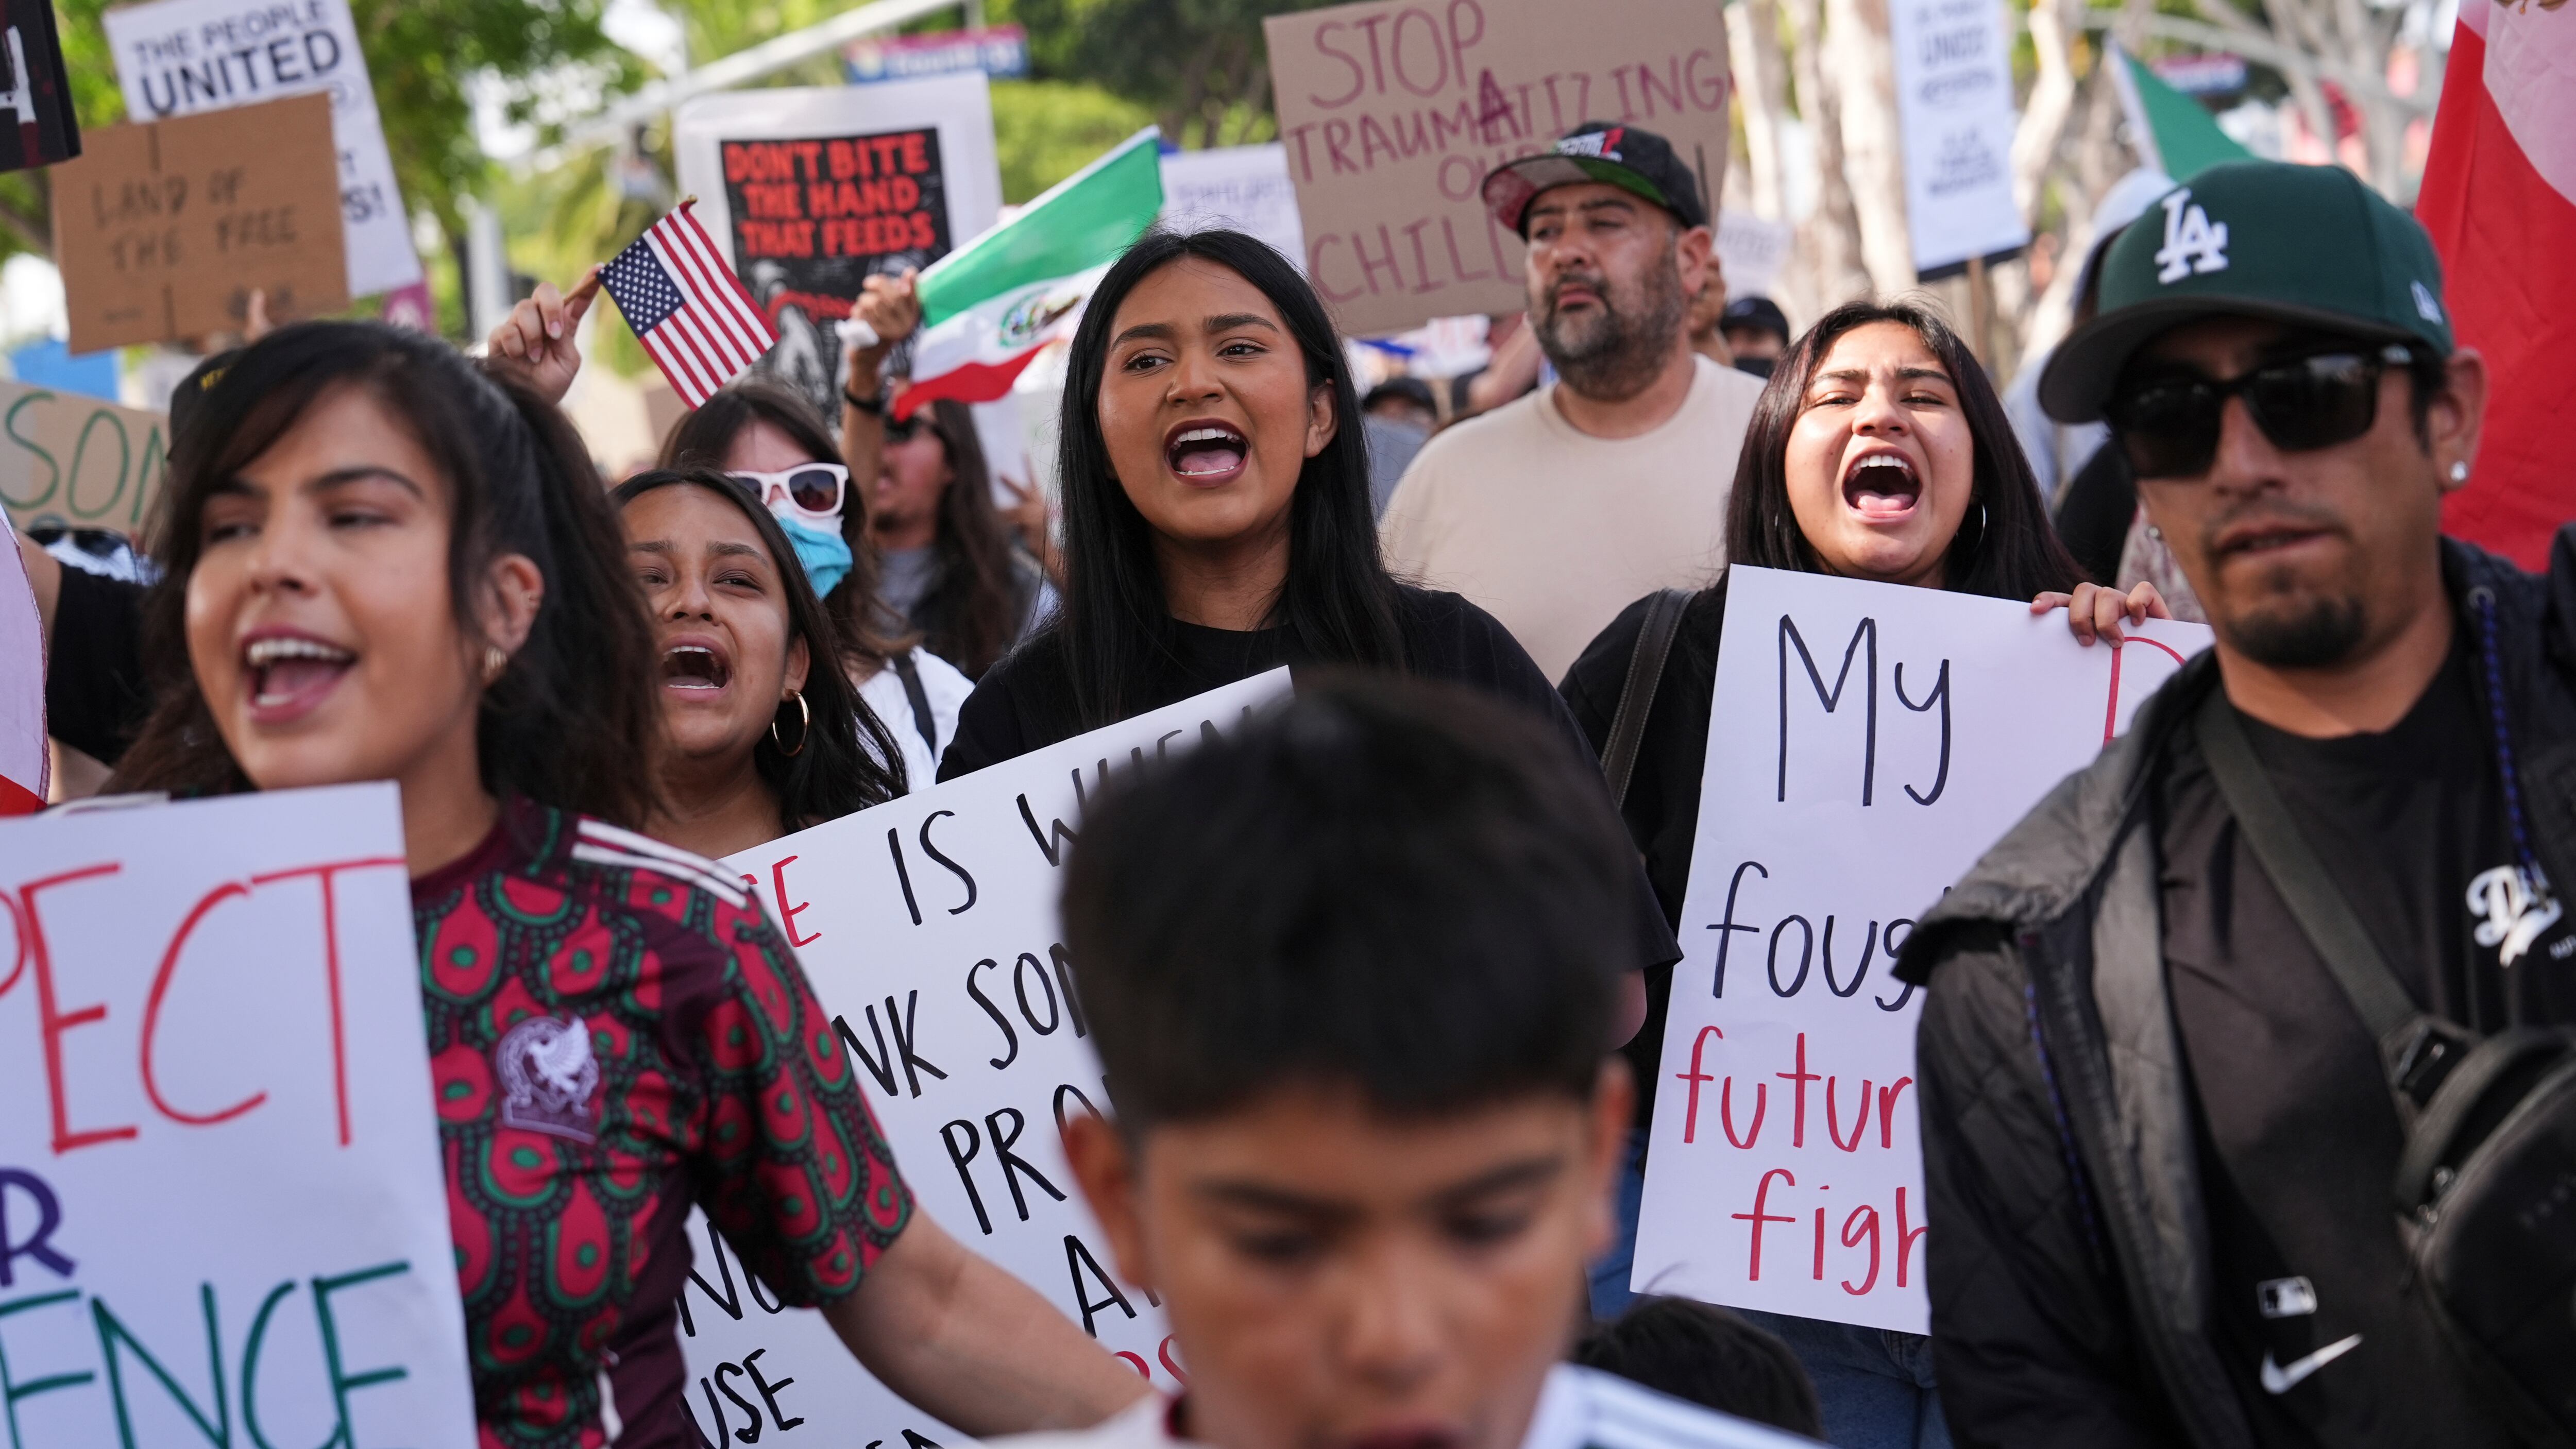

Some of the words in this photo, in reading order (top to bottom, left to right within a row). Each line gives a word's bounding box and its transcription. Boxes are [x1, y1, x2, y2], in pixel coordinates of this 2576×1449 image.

[141, 29, 340, 115] UNITED
[1309, 0, 1486, 109] STOP
[92, 174, 189, 228] LAND
[209, 165, 245, 204] OF
[723, 140, 823, 183] DON'T
[827, 132, 931, 181] BITE
[740, 181, 803, 219] THE
[808, 174, 920, 219] HAND
[111, 226, 181, 271] THE
[216, 206, 296, 252] FREE
[738, 219, 816, 257] THAT
[821, 210, 936, 258] FEEDS
[2154, 187, 2229, 284] LA
[1777, 613, 1951, 807] My
[887, 809, 978, 926] IS
[1706, 861, 1953, 1013] foug
[681, 1348, 805, 1449] USE
